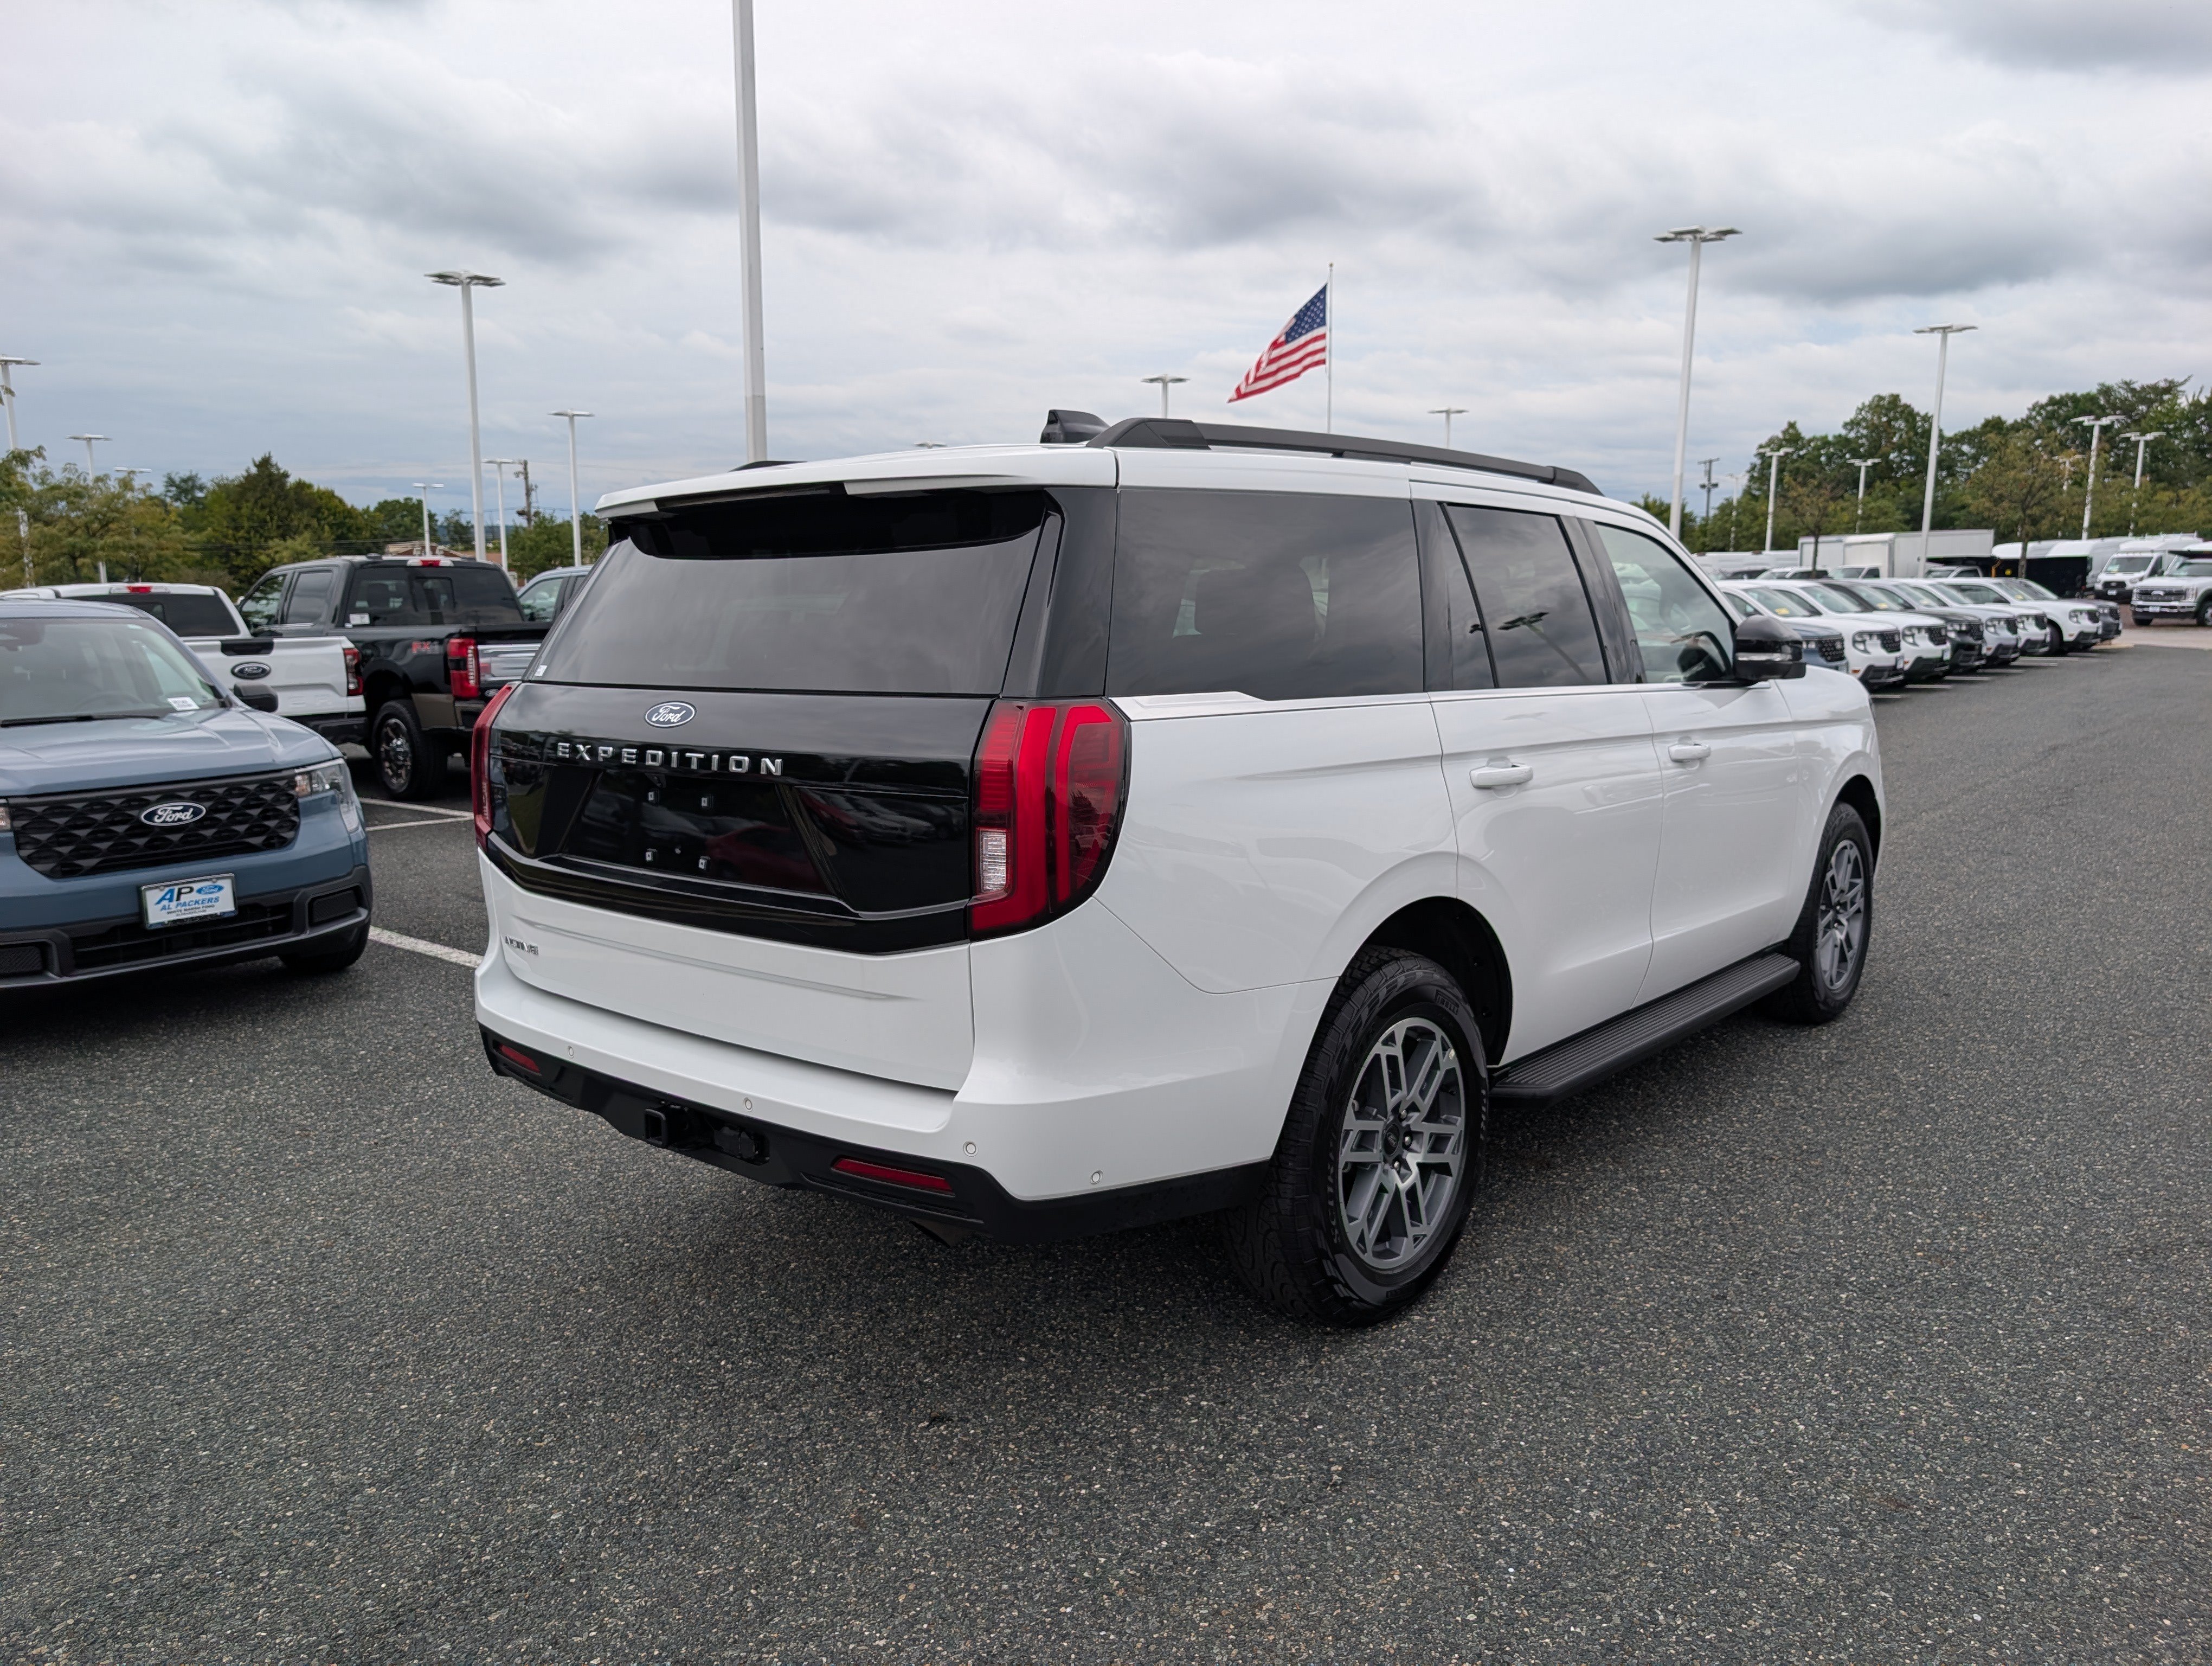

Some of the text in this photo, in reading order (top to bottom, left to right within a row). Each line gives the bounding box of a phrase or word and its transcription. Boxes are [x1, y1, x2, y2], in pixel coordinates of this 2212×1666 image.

[652, 705, 686, 722] Ford
[557, 742, 783, 776] EXPEDITION
[154, 806, 194, 823] Ford
[154, 886, 194, 905] AP
[176, 896, 220, 908] PACKERS
[1434, 989, 1459, 1015] PIRELLI
